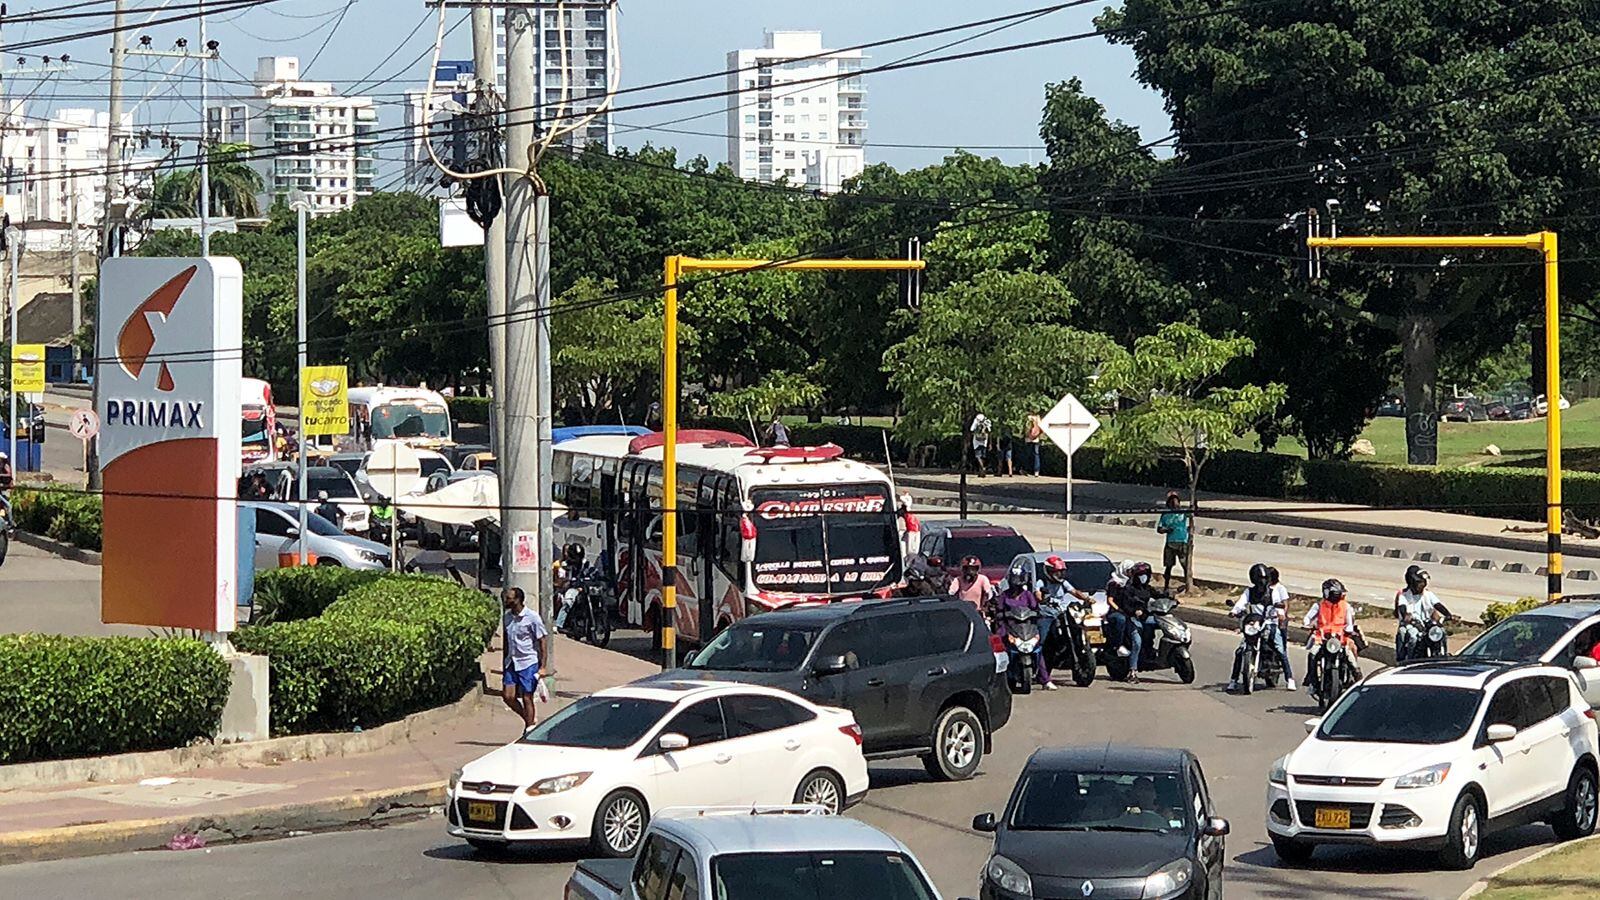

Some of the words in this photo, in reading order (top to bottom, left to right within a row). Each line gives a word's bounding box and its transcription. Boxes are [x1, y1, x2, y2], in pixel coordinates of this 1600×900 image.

[107, 400, 203, 428] PRIMAX
[305, 415, 347, 425] tucarro
[830, 558, 855, 566] CENTRO
[831, 572, 839, 582] A
